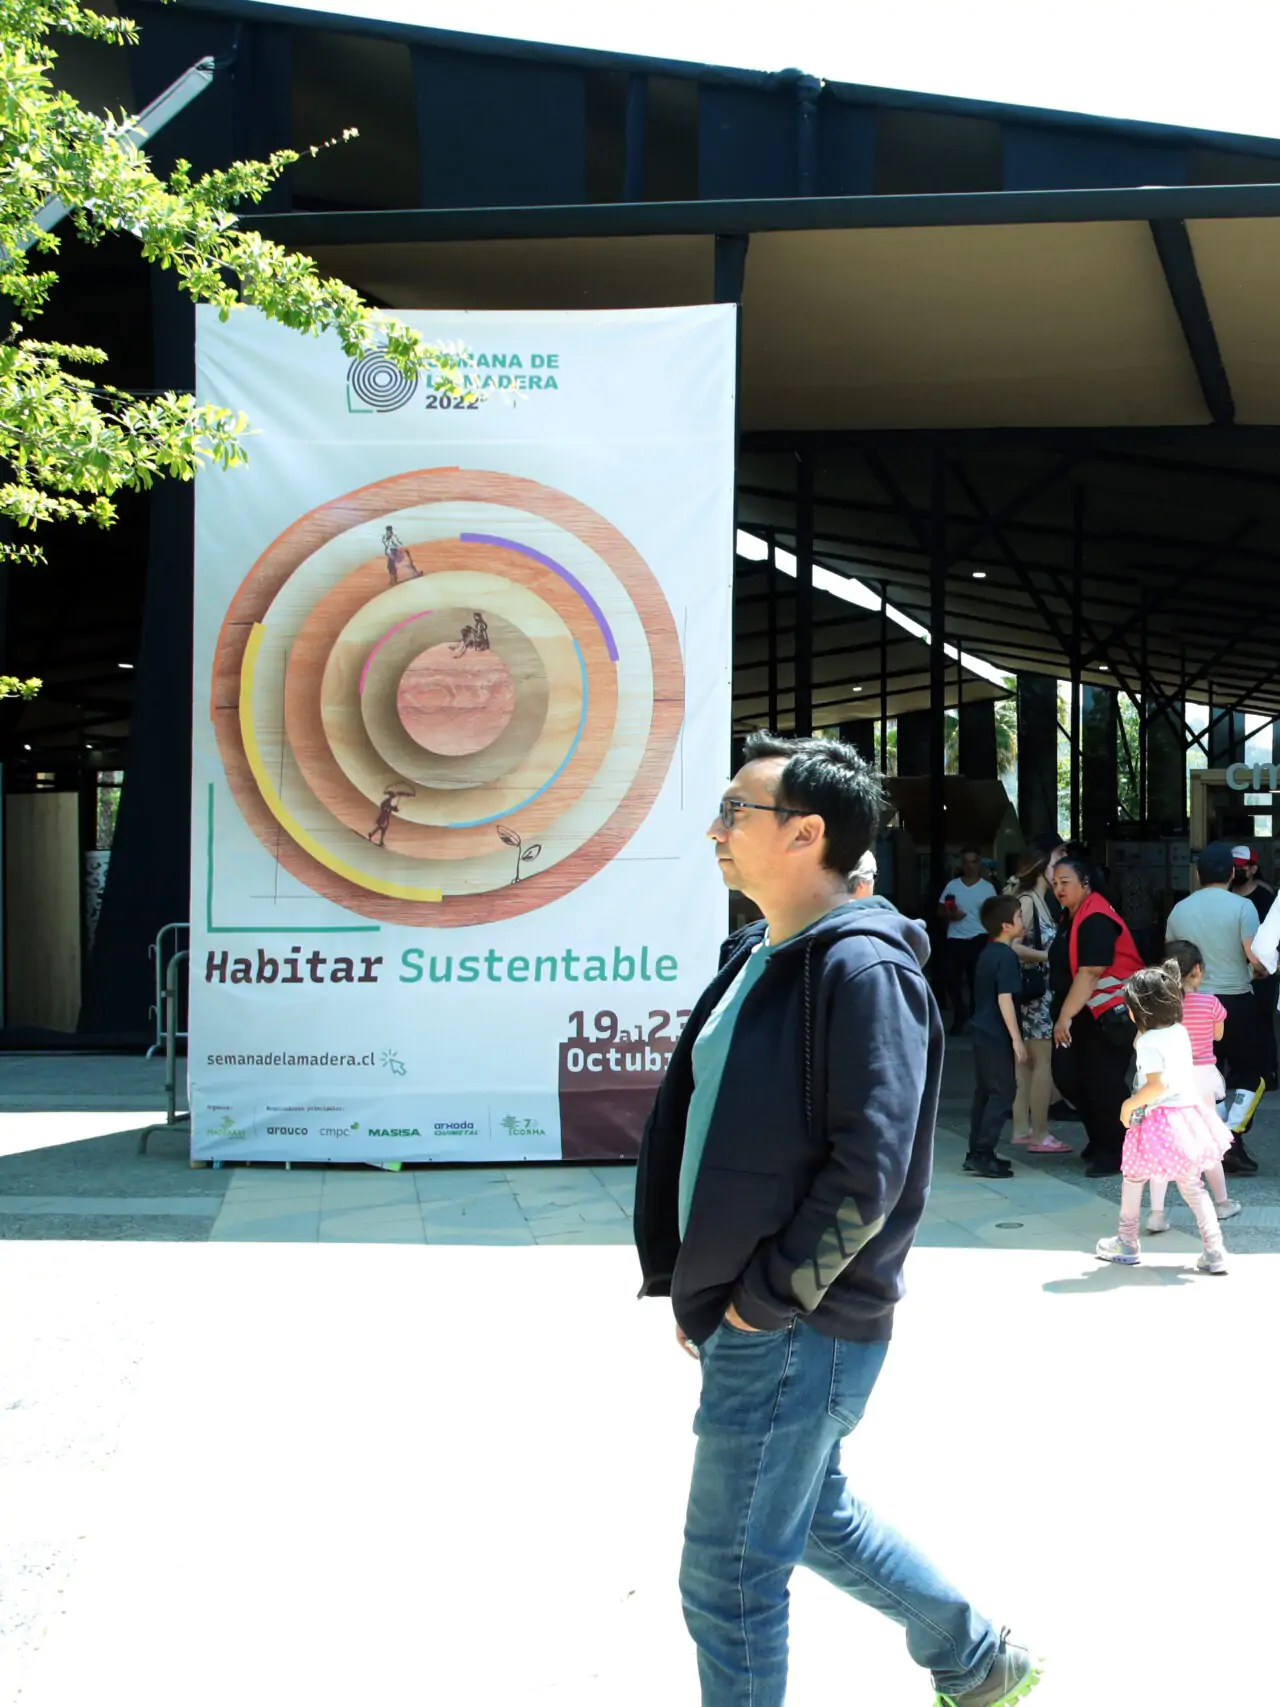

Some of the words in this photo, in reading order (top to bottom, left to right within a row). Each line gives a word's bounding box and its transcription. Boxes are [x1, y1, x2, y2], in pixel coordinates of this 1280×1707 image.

[427, 353, 522, 369] MANA
[531, 354, 559, 369] DE
[205, 946, 383, 984] Habitar
[399, 946, 678, 983] Sustentable
[206, 1052, 375, 1066] semanadelamadera.cl
[266, 1126, 308, 1136] arauco
[434, 1121, 474, 1130] arxada
[319, 1127, 350, 1139] cmpc
[368, 1128, 421, 1137] MASISA
